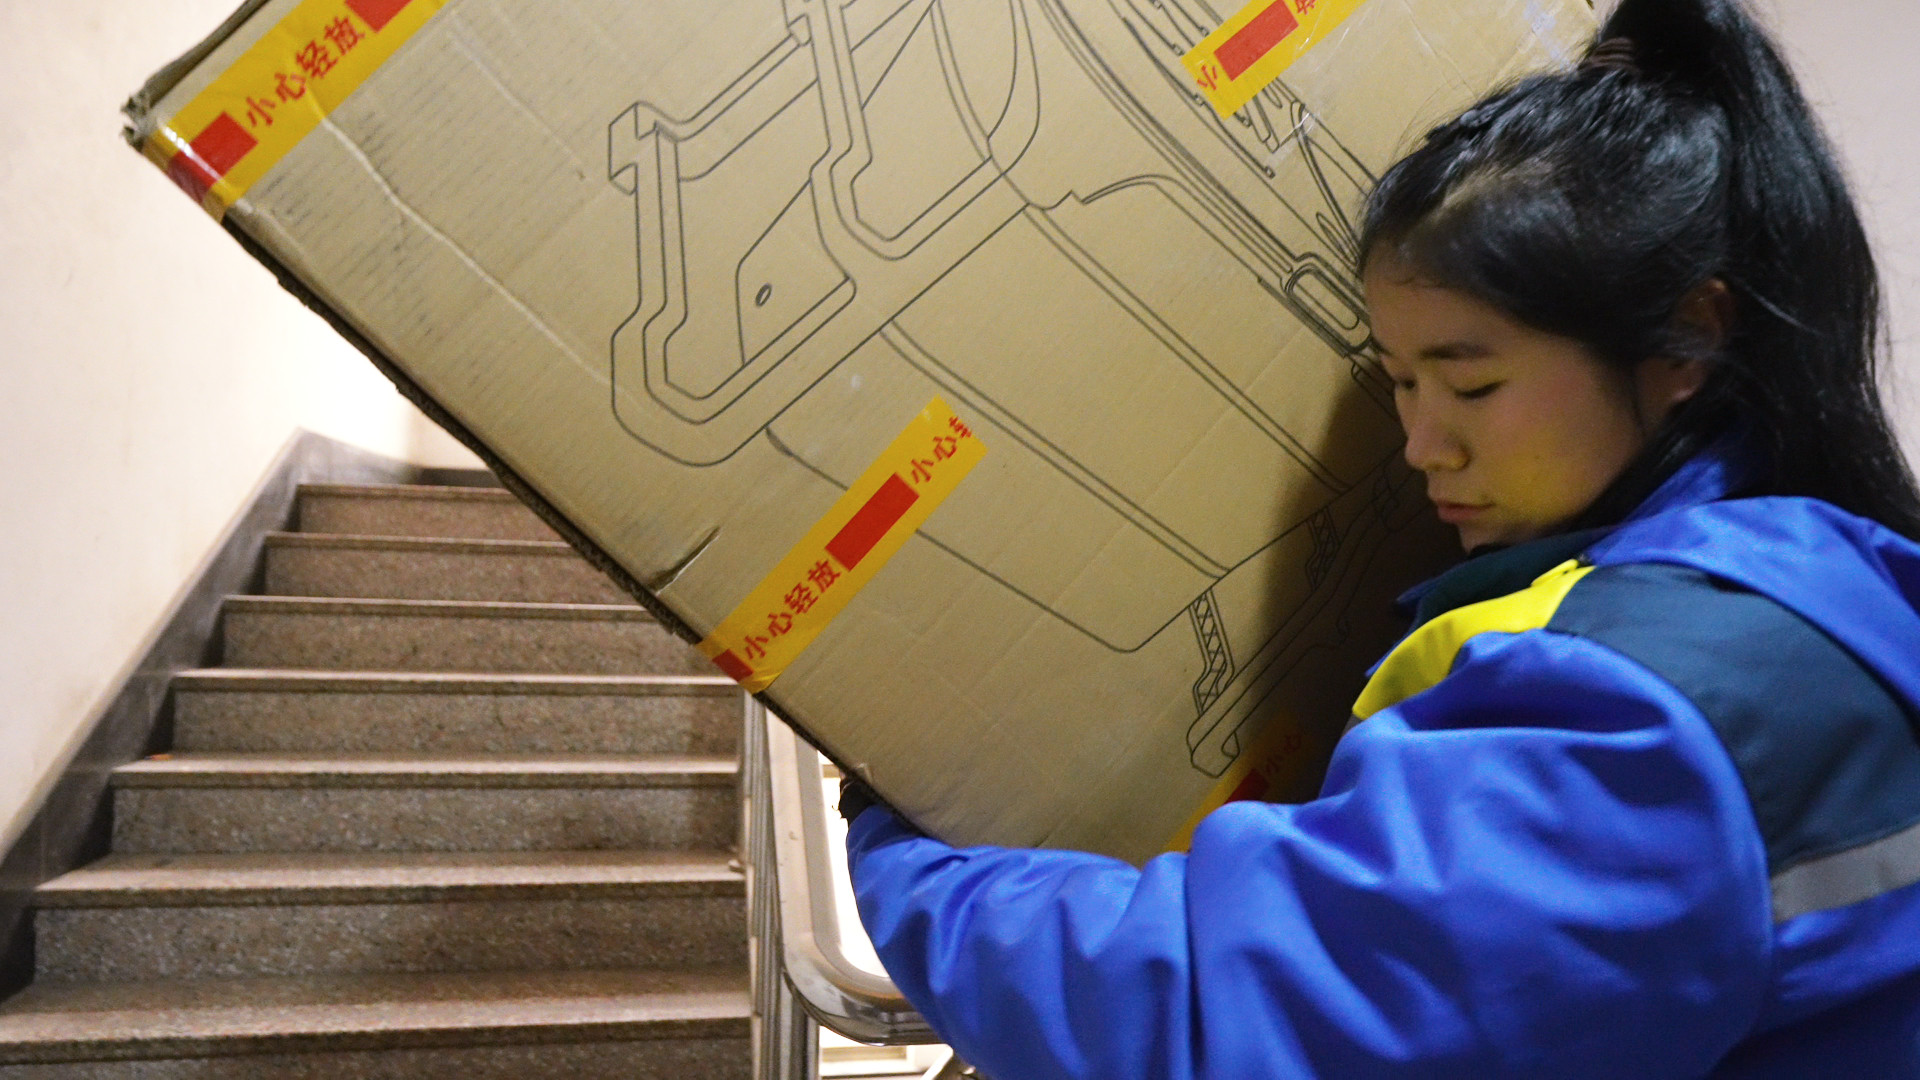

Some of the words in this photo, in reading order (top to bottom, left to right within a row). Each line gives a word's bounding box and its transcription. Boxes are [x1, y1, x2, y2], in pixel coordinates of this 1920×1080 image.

[246, 15, 366, 127] 小心轻放
[742, 558, 842, 662] 小心轻放
